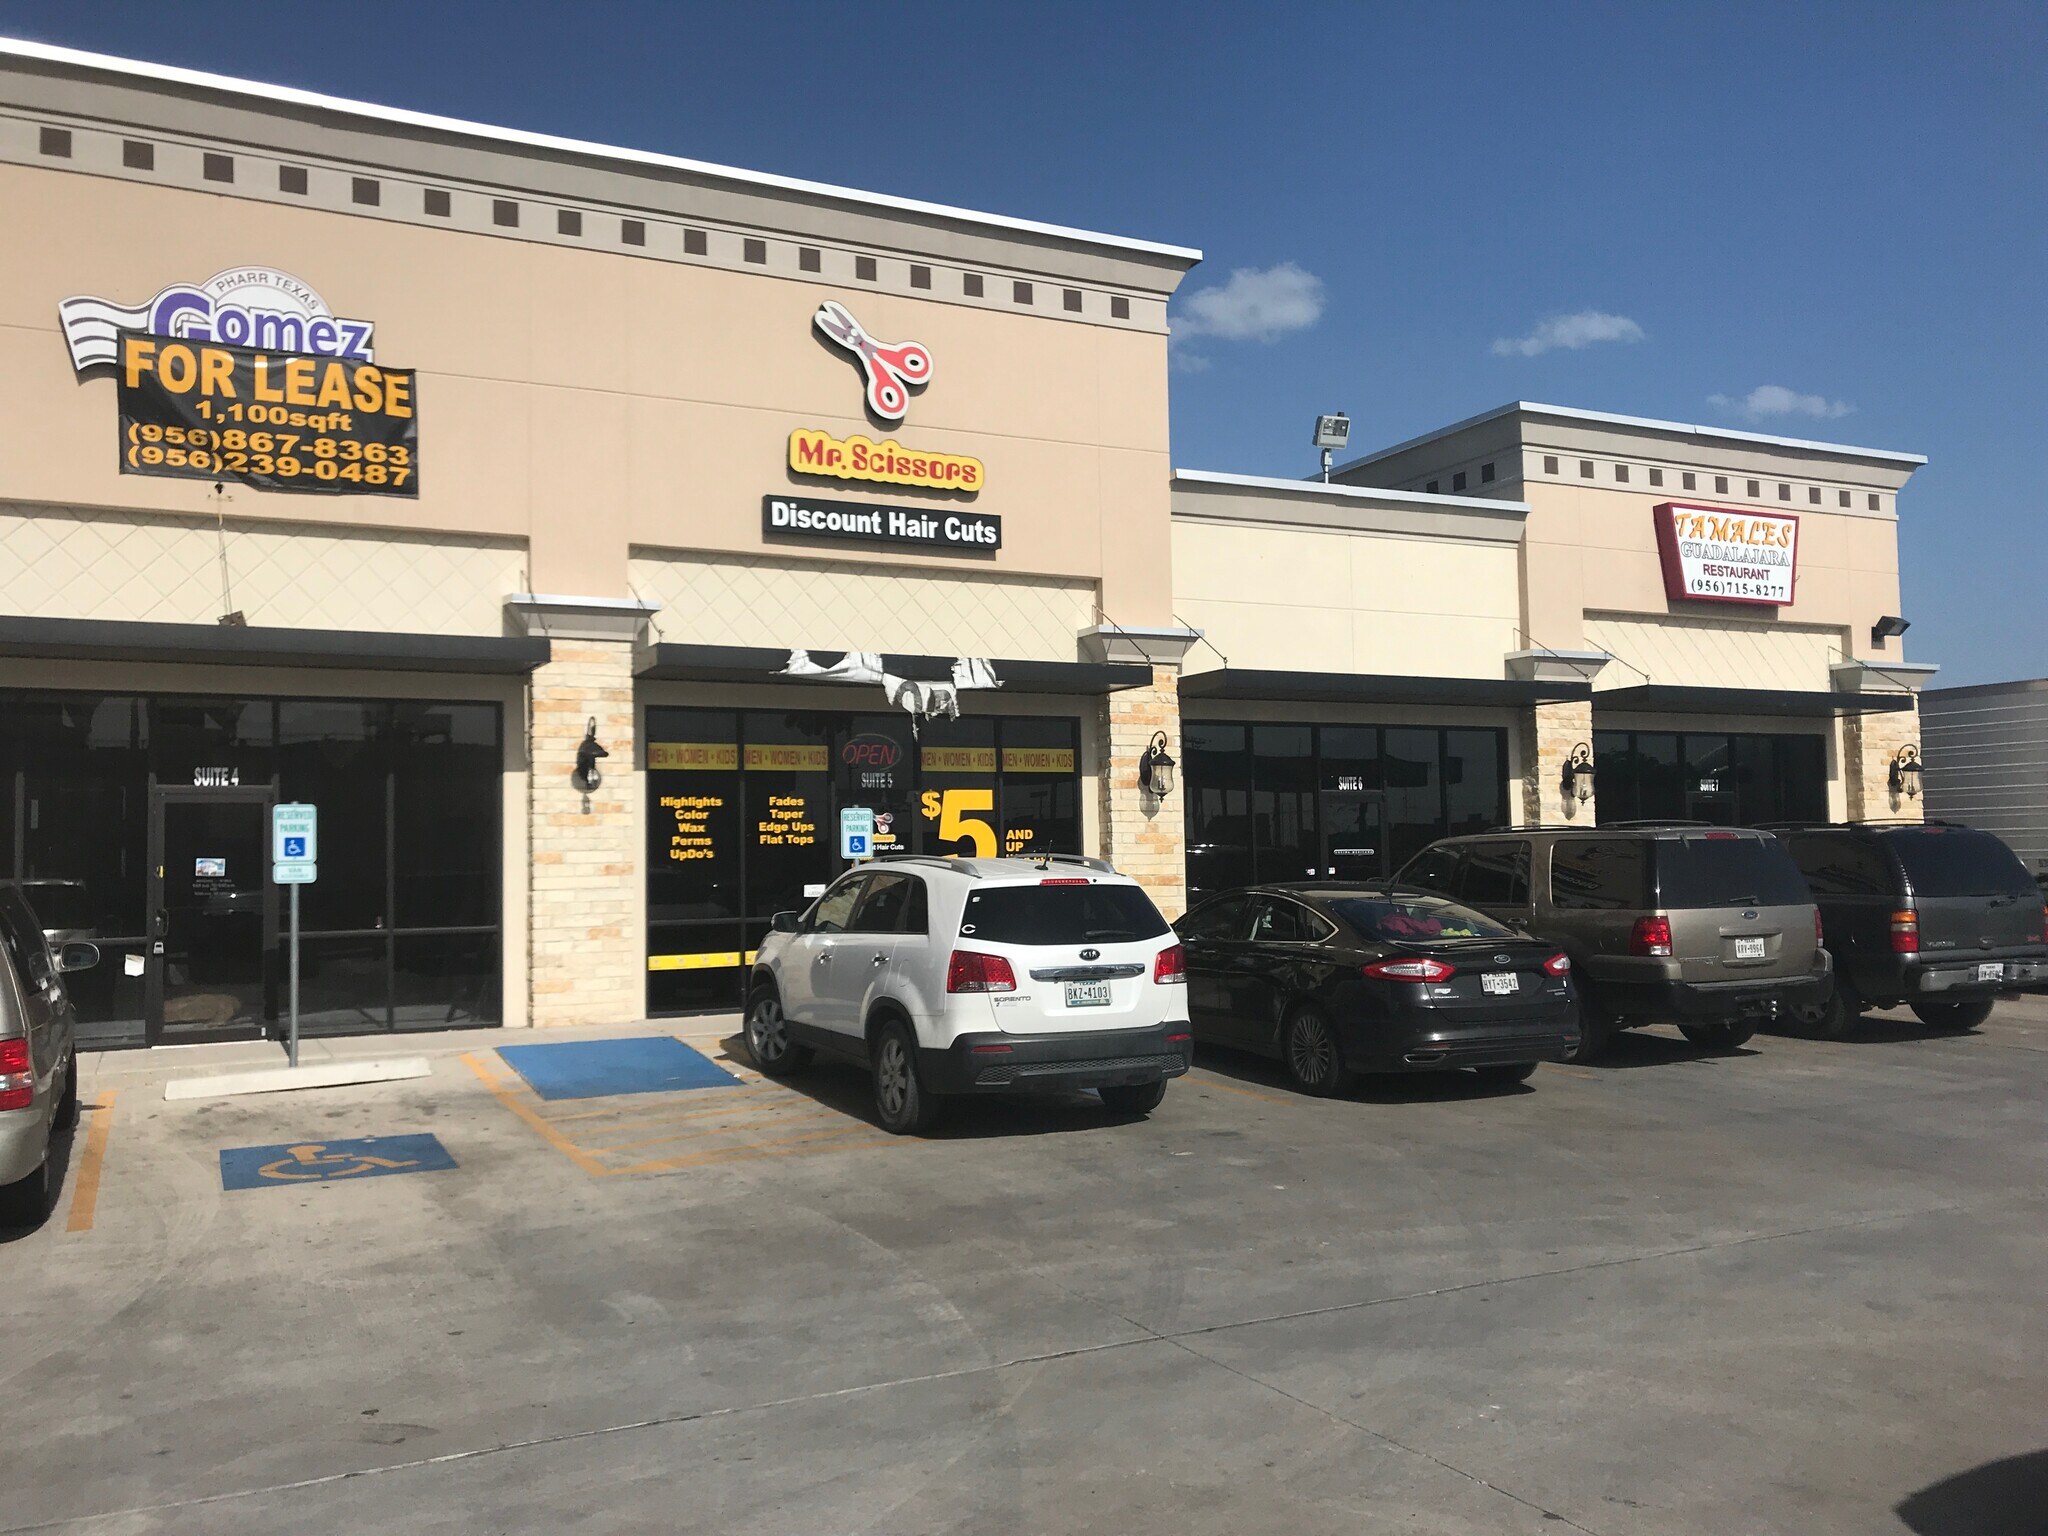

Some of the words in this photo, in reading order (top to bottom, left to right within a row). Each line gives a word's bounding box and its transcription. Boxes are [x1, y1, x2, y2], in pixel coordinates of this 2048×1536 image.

[216, 272, 269, 292] PHARR
[275, 275, 319, 310] TEXAS
[154, 291, 371, 359] Gomez
[125, 339, 238, 400] FOR
[254, 354, 413, 419] LEASE
[195, 400, 352, 432] 1,100sqft
[127, 422, 410, 466] (956)867-8363
[127, 445, 411, 487] (956)239-0487
[798, 437, 847, 470] Mr.
[852, 443, 977, 483] Scissors
[771, 501, 882, 535] Discount
[888, 511, 939, 539] Hair
[944, 517, 997, 544] Cuts
[1674, 512, 1793, 548] TAMALES
[1680, 541, 1790, 567] GUADALAJARA
[1703, 563, 1770, 581] RESTAURANT
[1691, 579, 1784, 598] (956)715-8277
[675, 748, 709, 764] WOMEN
[716, 749, 736, 765] KIDS
[744, 749, 763, 765] MEN
[769, 750, 801, 766] WOMEN
[807, 750, 827, 766] KIDS
[842, 742, 896, 765] OPEN
[921, 751, 937, 766] MEN
[943, 752, 971, 767] WOMEN
[977, 752, 994, 767] KIDS
[1002, 752, 1018, 767] MEN
[1023, 753, 1051, 768] WOMEN
[1056, 753, 1073, 768] KIDS
[194, 767, 229, 787] SUITE
[231, 767, 239, 787] 4
[861, 772, 886, 788] SUITE
[887, 773, 893, 788] 5
[1338, 776, 1357, 791] SUITE
[1358, 776, 1363, 791] 6
[660, 796, 724, 809] Highlights
[769, 796, 804, 806] Fades
[675, 810, 710, 820] Color
[769, 809, 804, 821] Taper
[843, 813, 870, 821] RESERVED
[678, 823, 706, 833] Wax
[759, 822, 789, 833] Edge
[792, 822, 815, 833] Ups
[845, 824, 868, 832] PARKING
[1006, 829, 1034, 840] AND
[672, 836, 712, 847] Perms
[759, 835, 783, 845] Flat
[786, 835, 815, 846] Tops
[1005, 841, 1024, 852] UP
[1082, 951, 1098, 959] KIA
